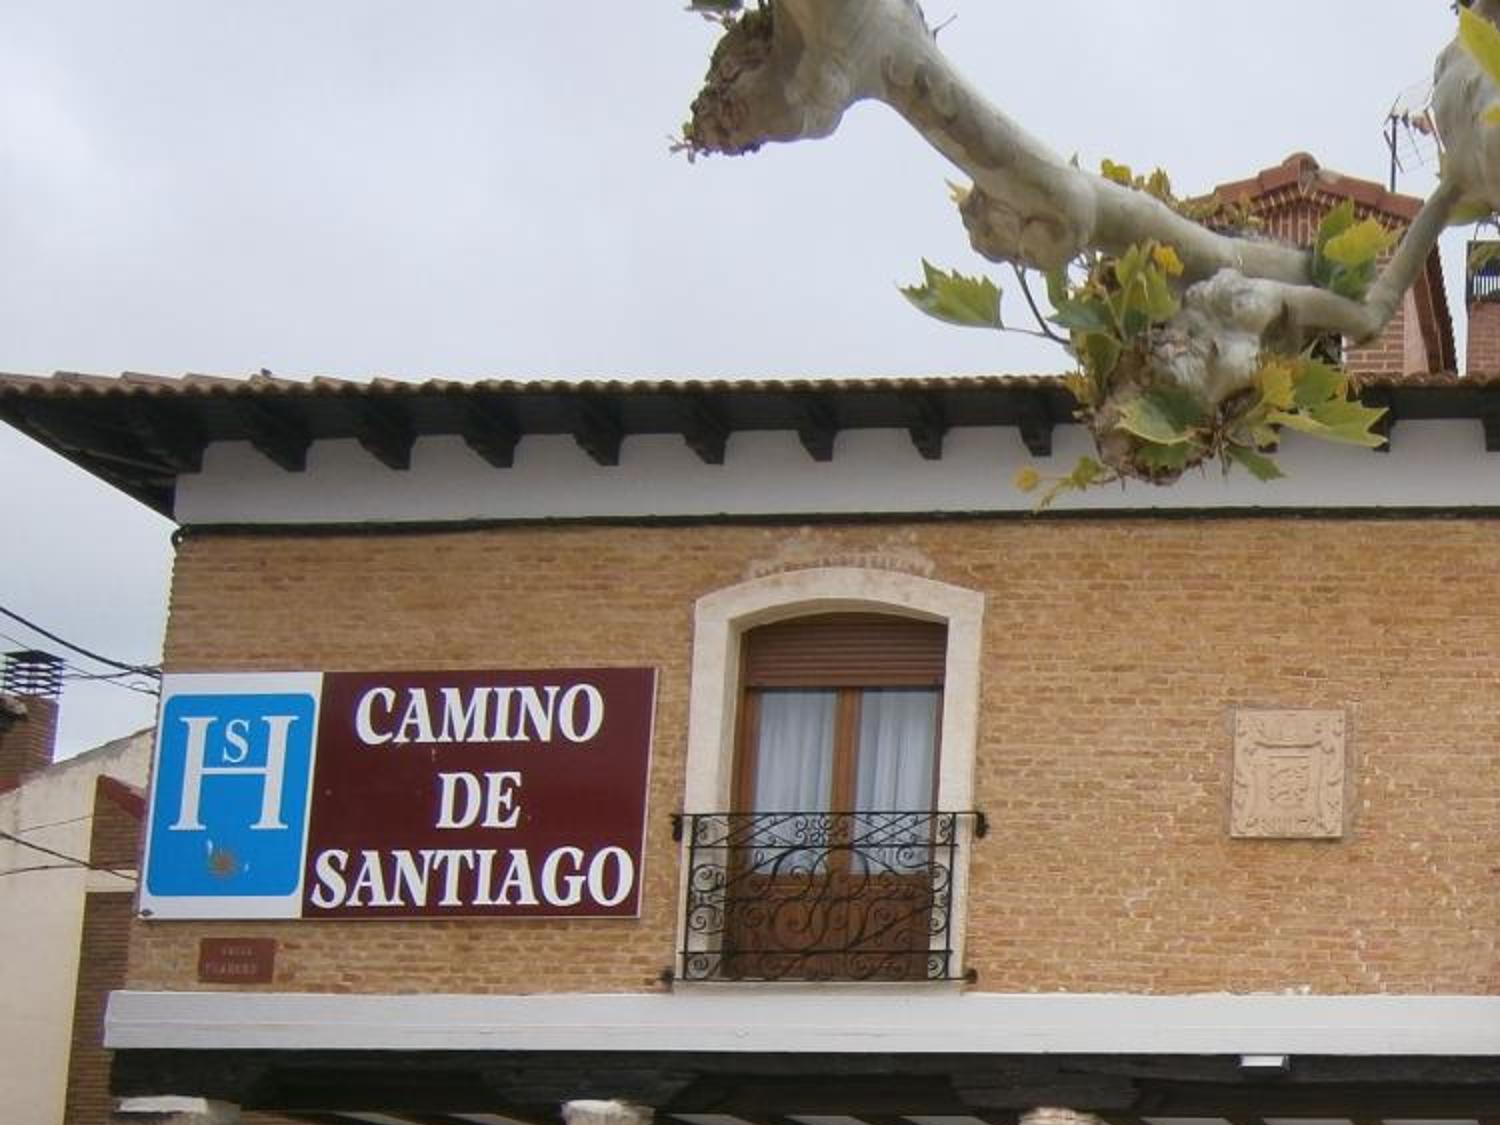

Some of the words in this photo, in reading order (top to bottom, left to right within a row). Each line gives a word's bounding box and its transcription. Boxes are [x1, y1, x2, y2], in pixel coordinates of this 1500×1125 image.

[355, 684, 604, 745] CAMINO
[435, 771, 522, 830] DE
[310, 846, 635, 909] SANTIAGO
